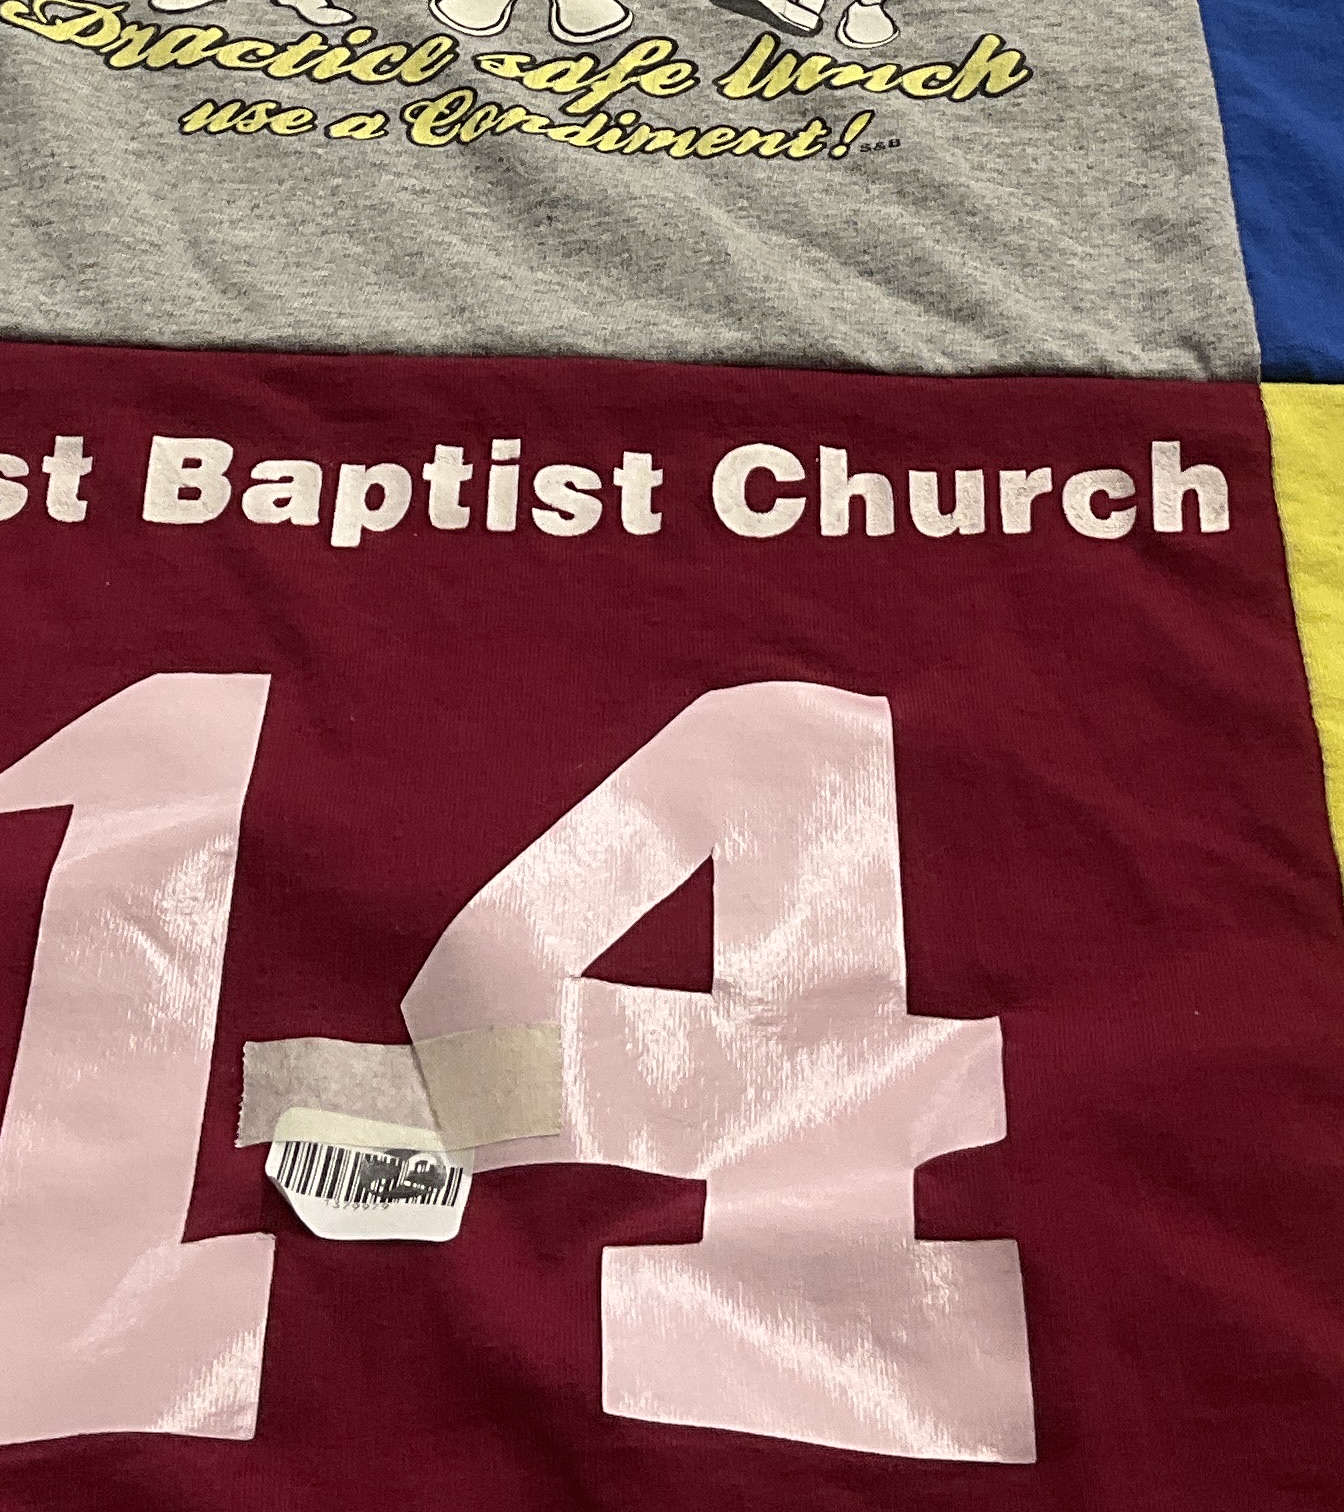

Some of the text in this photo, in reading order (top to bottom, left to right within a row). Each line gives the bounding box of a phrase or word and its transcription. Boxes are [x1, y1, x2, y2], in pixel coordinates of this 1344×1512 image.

[473, 35, 701, 116] safe
[718, 32, 1035, 101] lunch
[179, 99, 318, 138] use
[329, 108, 393, 143] a
[401, 89, 873, 162] Condiment!
[140, 434, 663, 549] Baptist
[710, 438, 1232, 541] Church
